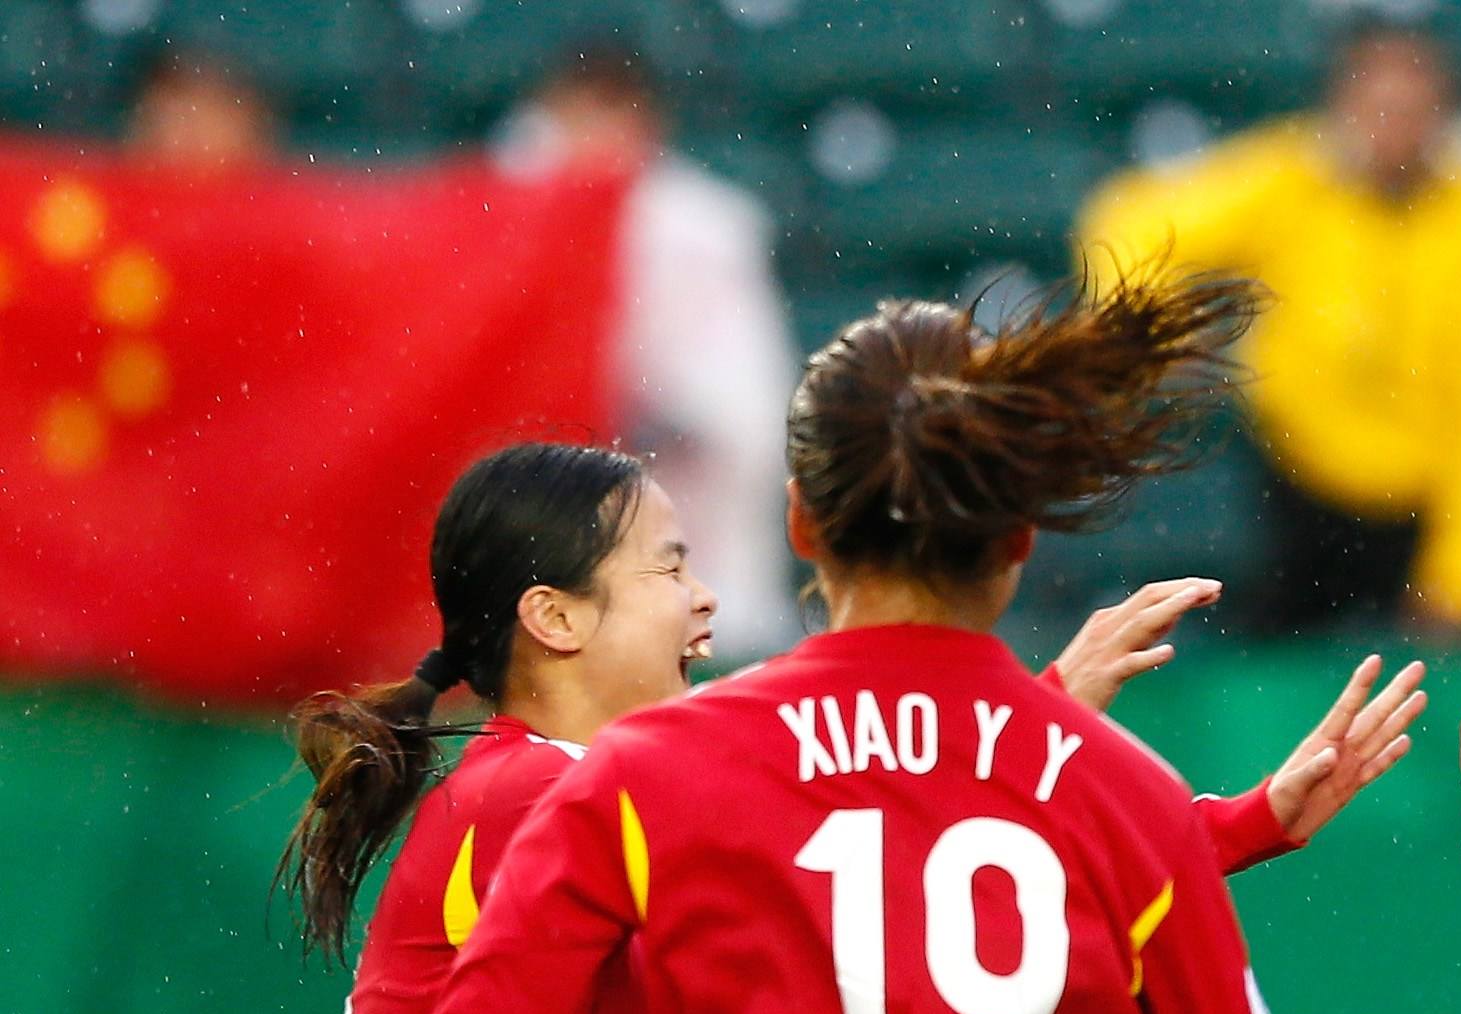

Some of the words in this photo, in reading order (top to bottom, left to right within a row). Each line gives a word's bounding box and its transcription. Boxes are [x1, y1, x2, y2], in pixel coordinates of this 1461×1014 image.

[777, 688, 939, 782] XIAO
[973, 699, 1013, 781] Y
[1033, 721, 1084, 803] Y
